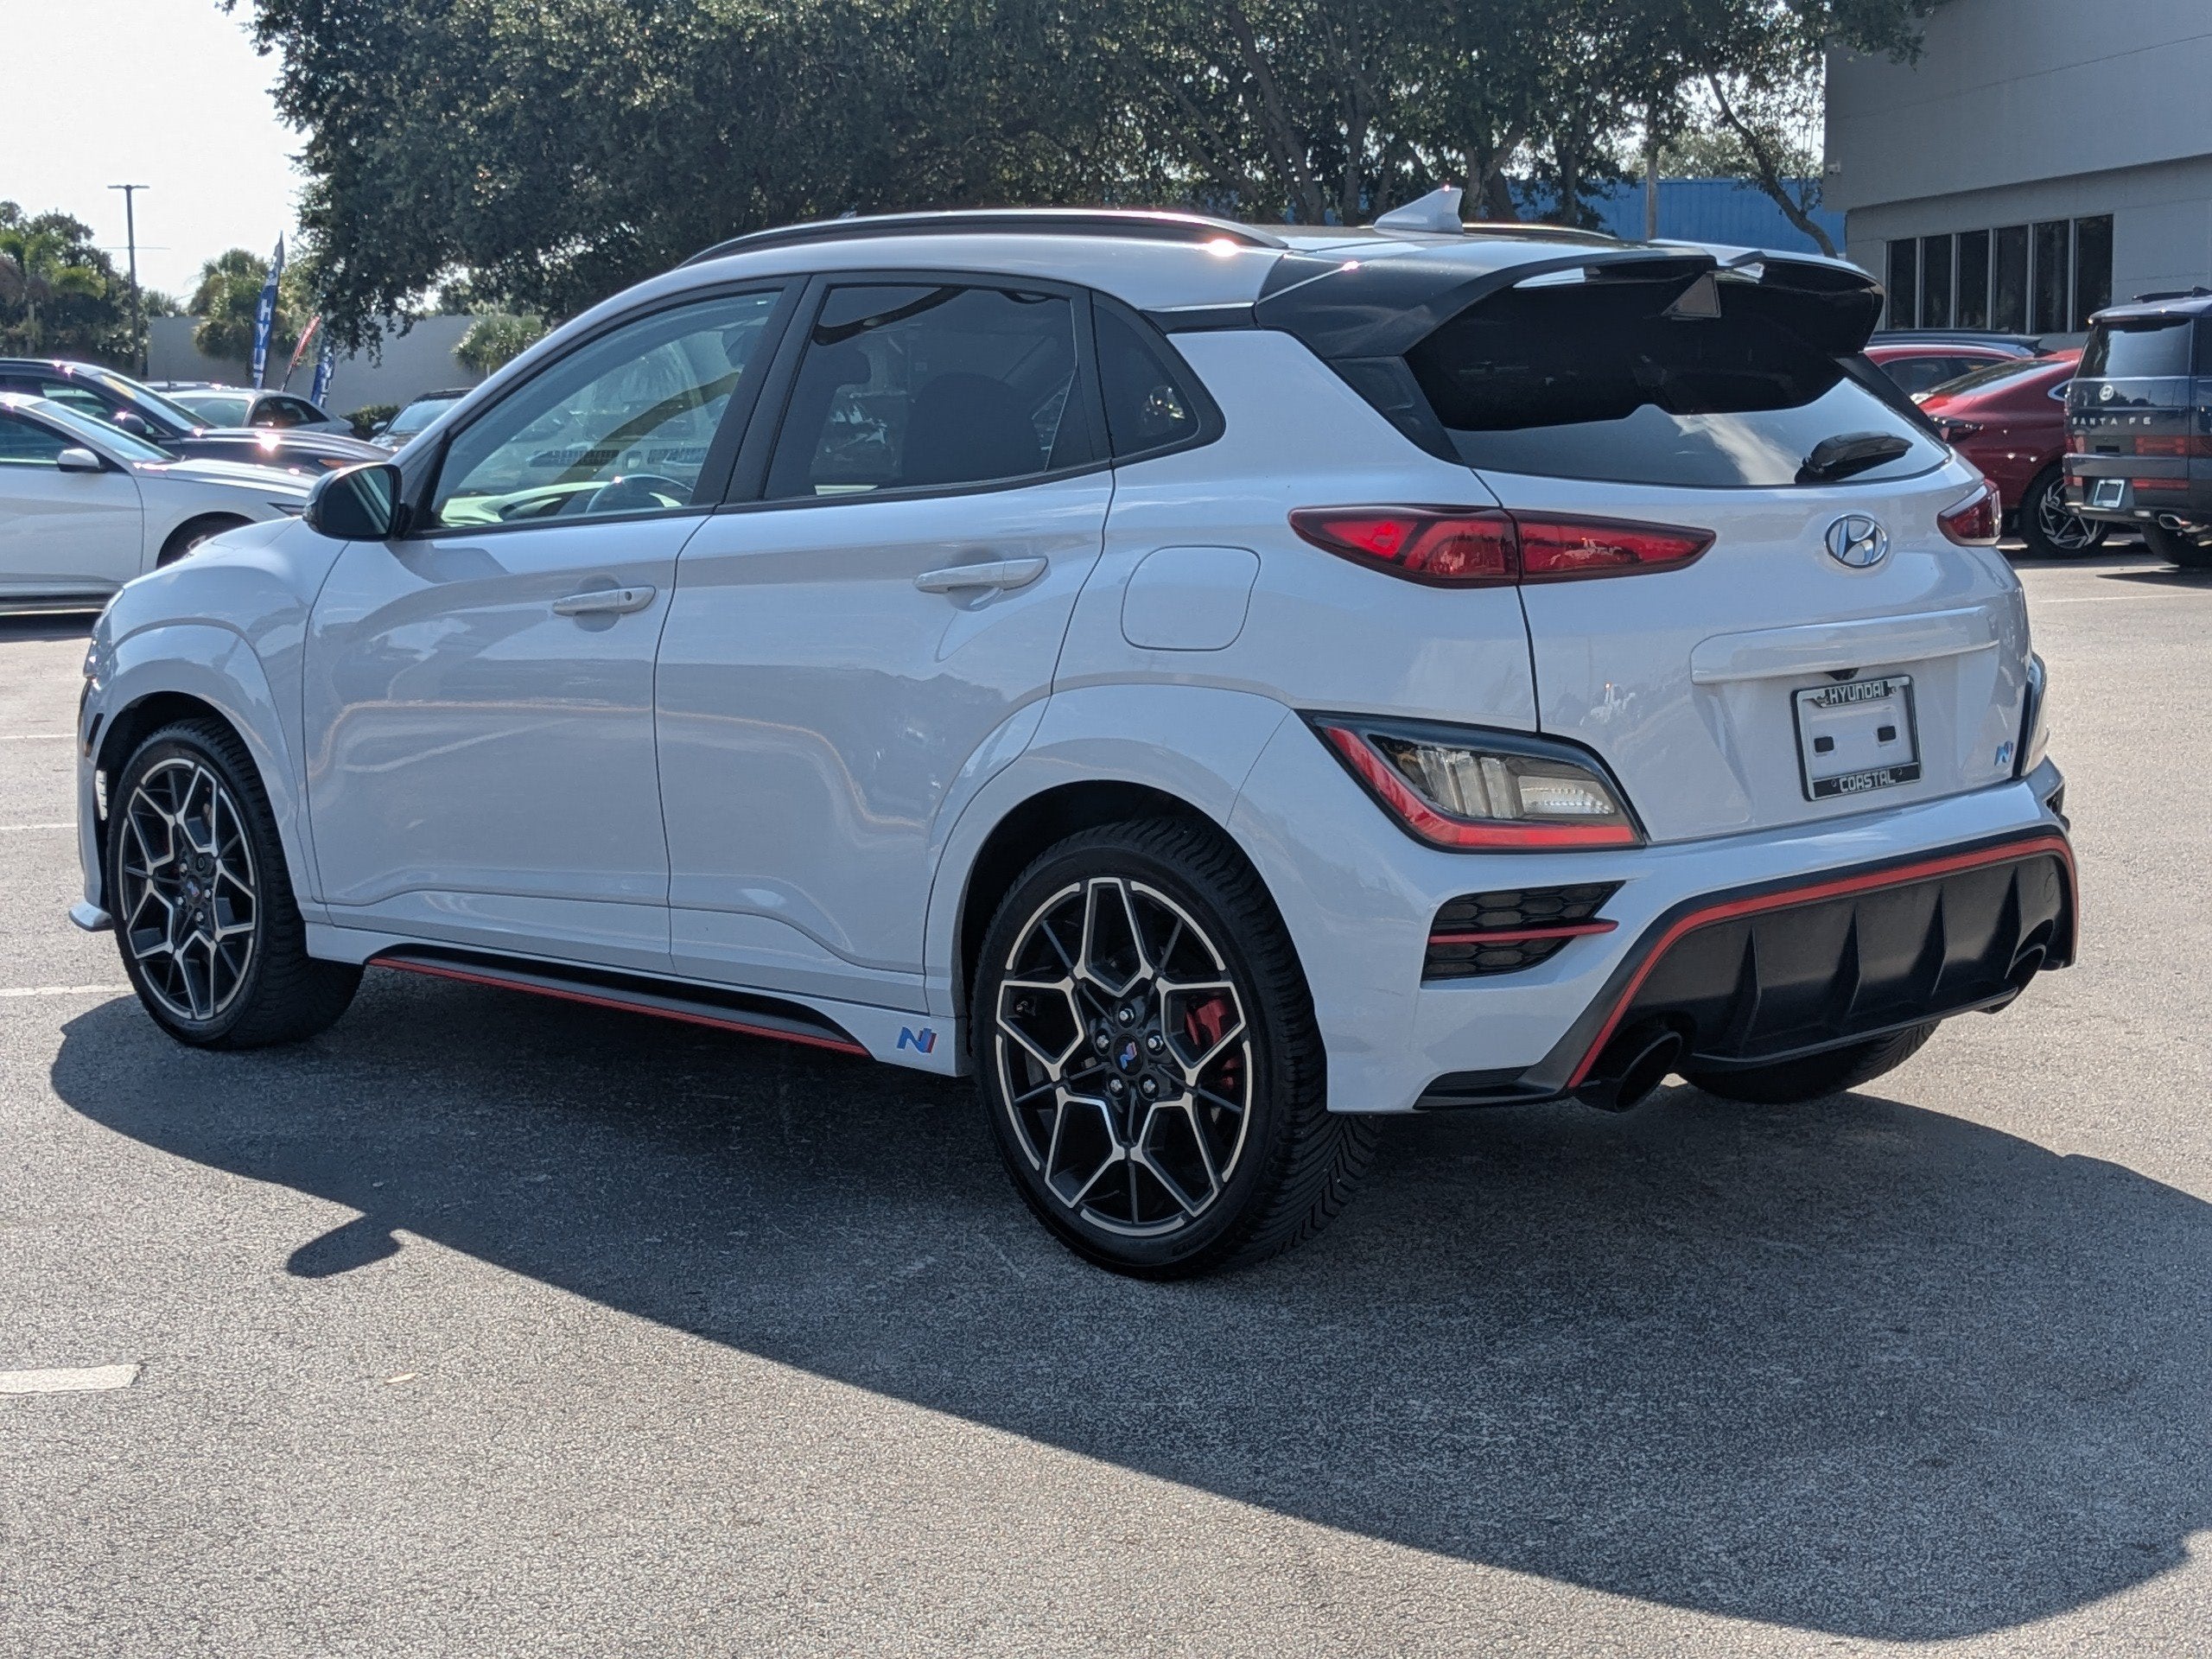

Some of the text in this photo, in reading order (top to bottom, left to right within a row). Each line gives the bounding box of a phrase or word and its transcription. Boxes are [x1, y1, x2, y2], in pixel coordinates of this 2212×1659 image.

[2072, 416, 2152, 425] SANTA FE
[1828, 682, 1885, 704] HYUNDAI
[1839, 769, 1897, 792] COASTAL
